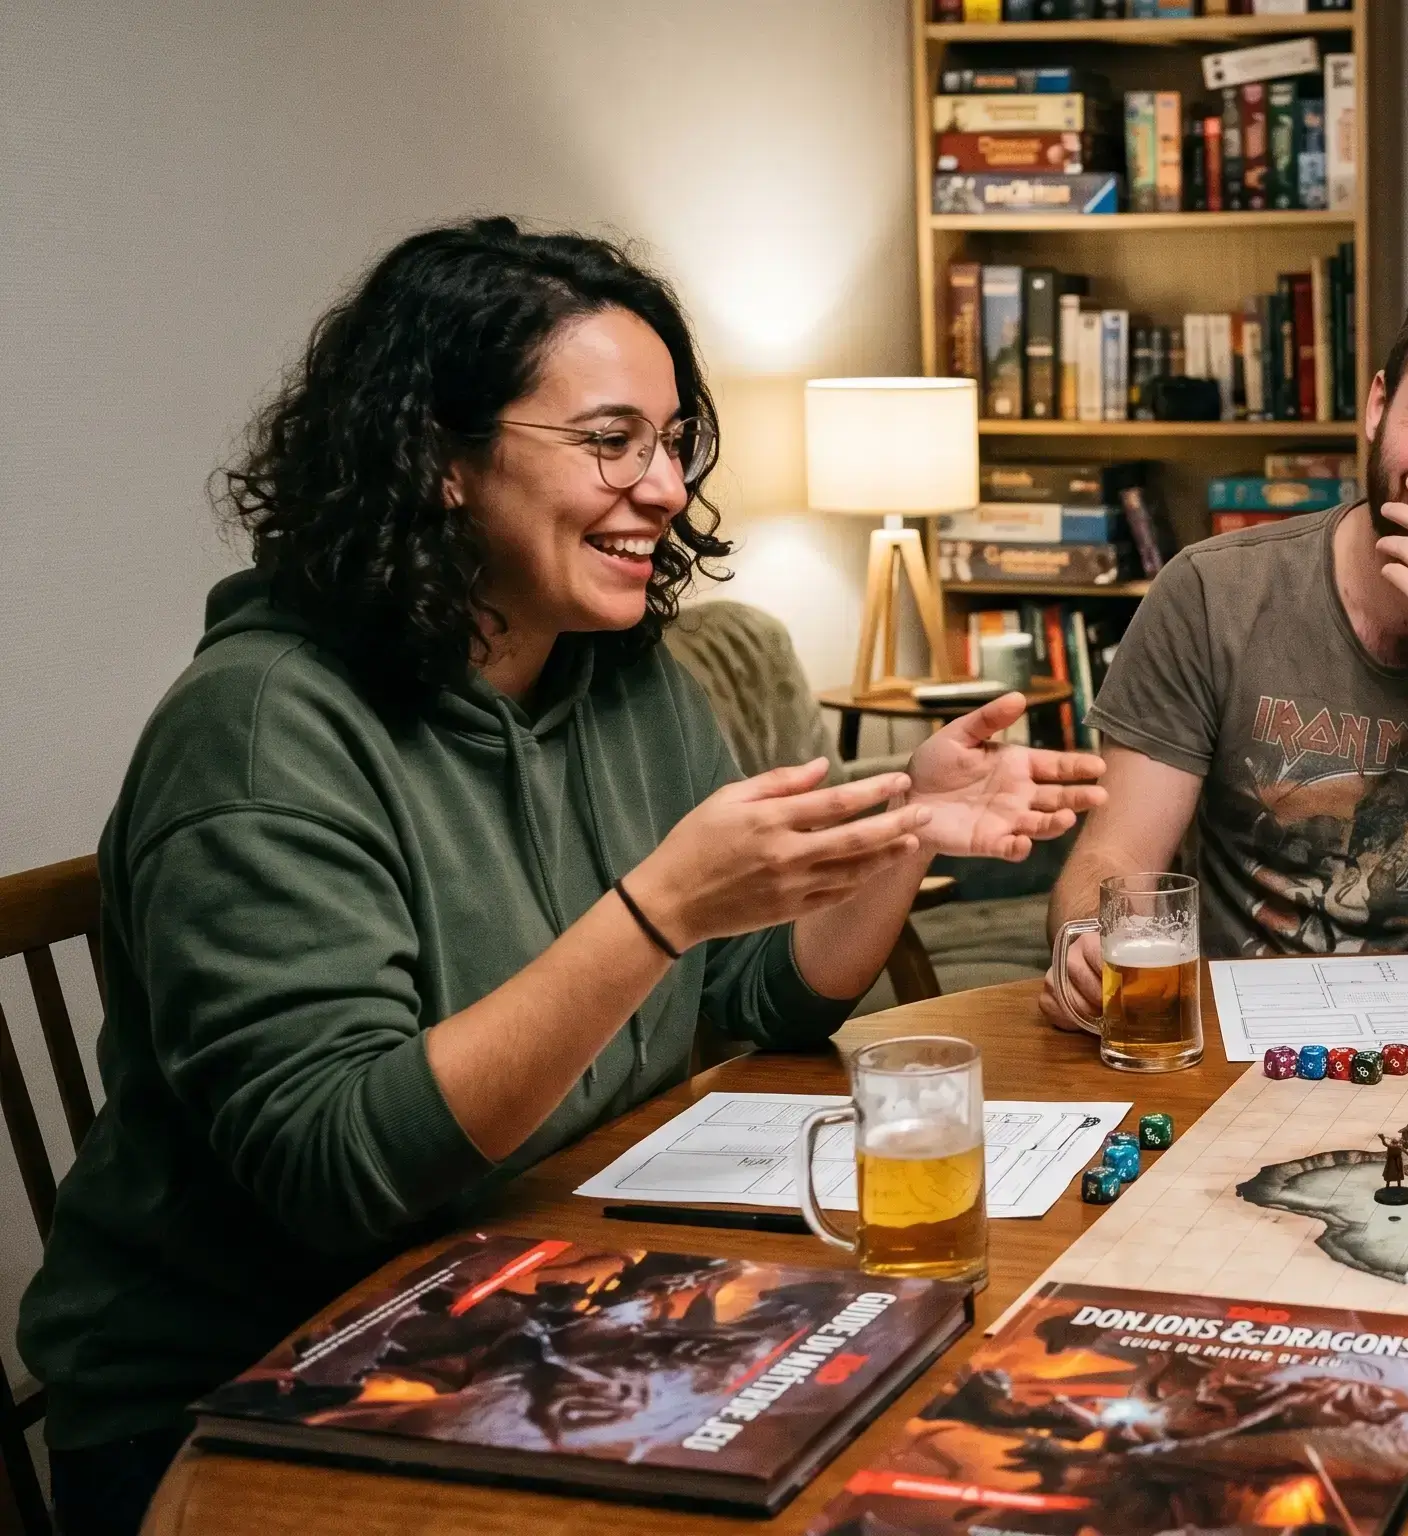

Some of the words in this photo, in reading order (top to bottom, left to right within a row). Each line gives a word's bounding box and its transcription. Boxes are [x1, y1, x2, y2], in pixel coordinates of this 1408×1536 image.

[1252, 695, 1371, 778] IRON
[817, 1292, 897, 1337] GUIDE
[1070, 1306, 1223, 1339] DONJONS
[1119, 1336, 1172, 1351] GUIDE
[682, 1416, 744, 1452] JEU
